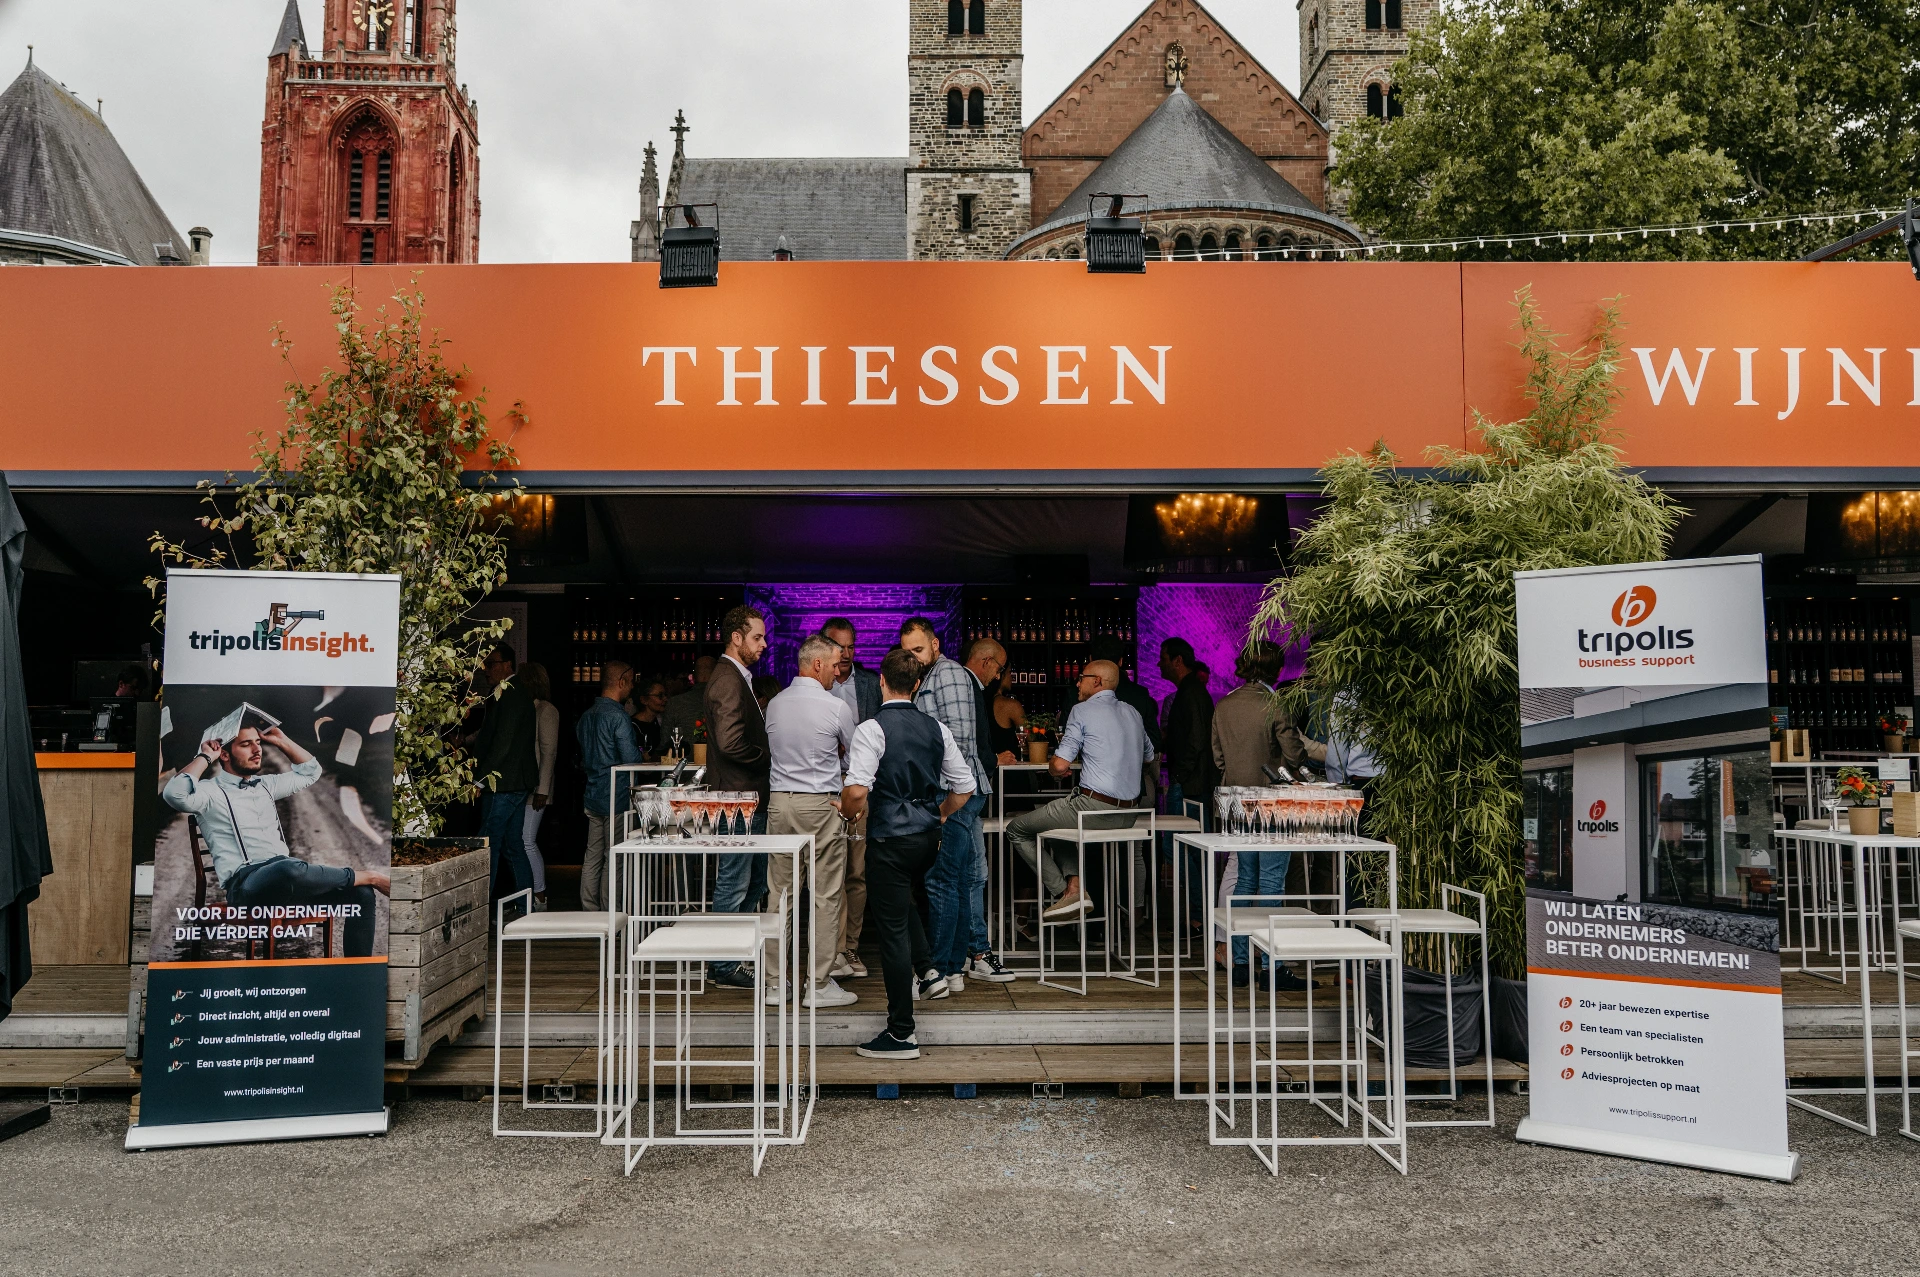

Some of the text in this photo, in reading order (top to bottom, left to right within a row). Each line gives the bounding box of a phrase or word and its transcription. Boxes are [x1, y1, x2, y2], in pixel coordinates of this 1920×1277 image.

[642, 345, 1920, 420] THIESSEN WIJN
[1578, 625, 1694, 656] tripolis
[1579, 654, 1695, 668] business support
[1577, 819, 1619, 834] tripolis
[176, 904, 362, 921] VOOR DE ONDERNEMER
[1544, 900, 1641, 922] WIJ LATEN
[175, 924, 316, 941] DIE VÉRDER GAAT
[1545, 920, 1686, 944] ONDERNEMERS
[1546, 939, 1750, 970] BETER ONDERNEMEN!
[200, 986, 307, 999] Jij groeit, wij ontzorgen
[199, 1008, 330, 1021] Direct inzicht, altijd en overal
[1579, 999, 1710, 1020] 20+ jaar bewezen expertise
[197, 1030, 361, 1045] Jouw administratie, volledig digitaal
[1580, 1023, 1704, 1044] Een team van specialisten
[196, 1054, 315, 1069] Een vaste prijs per maand
[1580, 1046, 1684, 1067] Persoonlijk betrokken
[223, 1085, 304, 1097] www.tripolisinsight.nl
[1581, 1071, 1701, 1093] Adviesprojecten op maat
[1608, 1106, 1697, 1124] www.tripolissupport.nl
